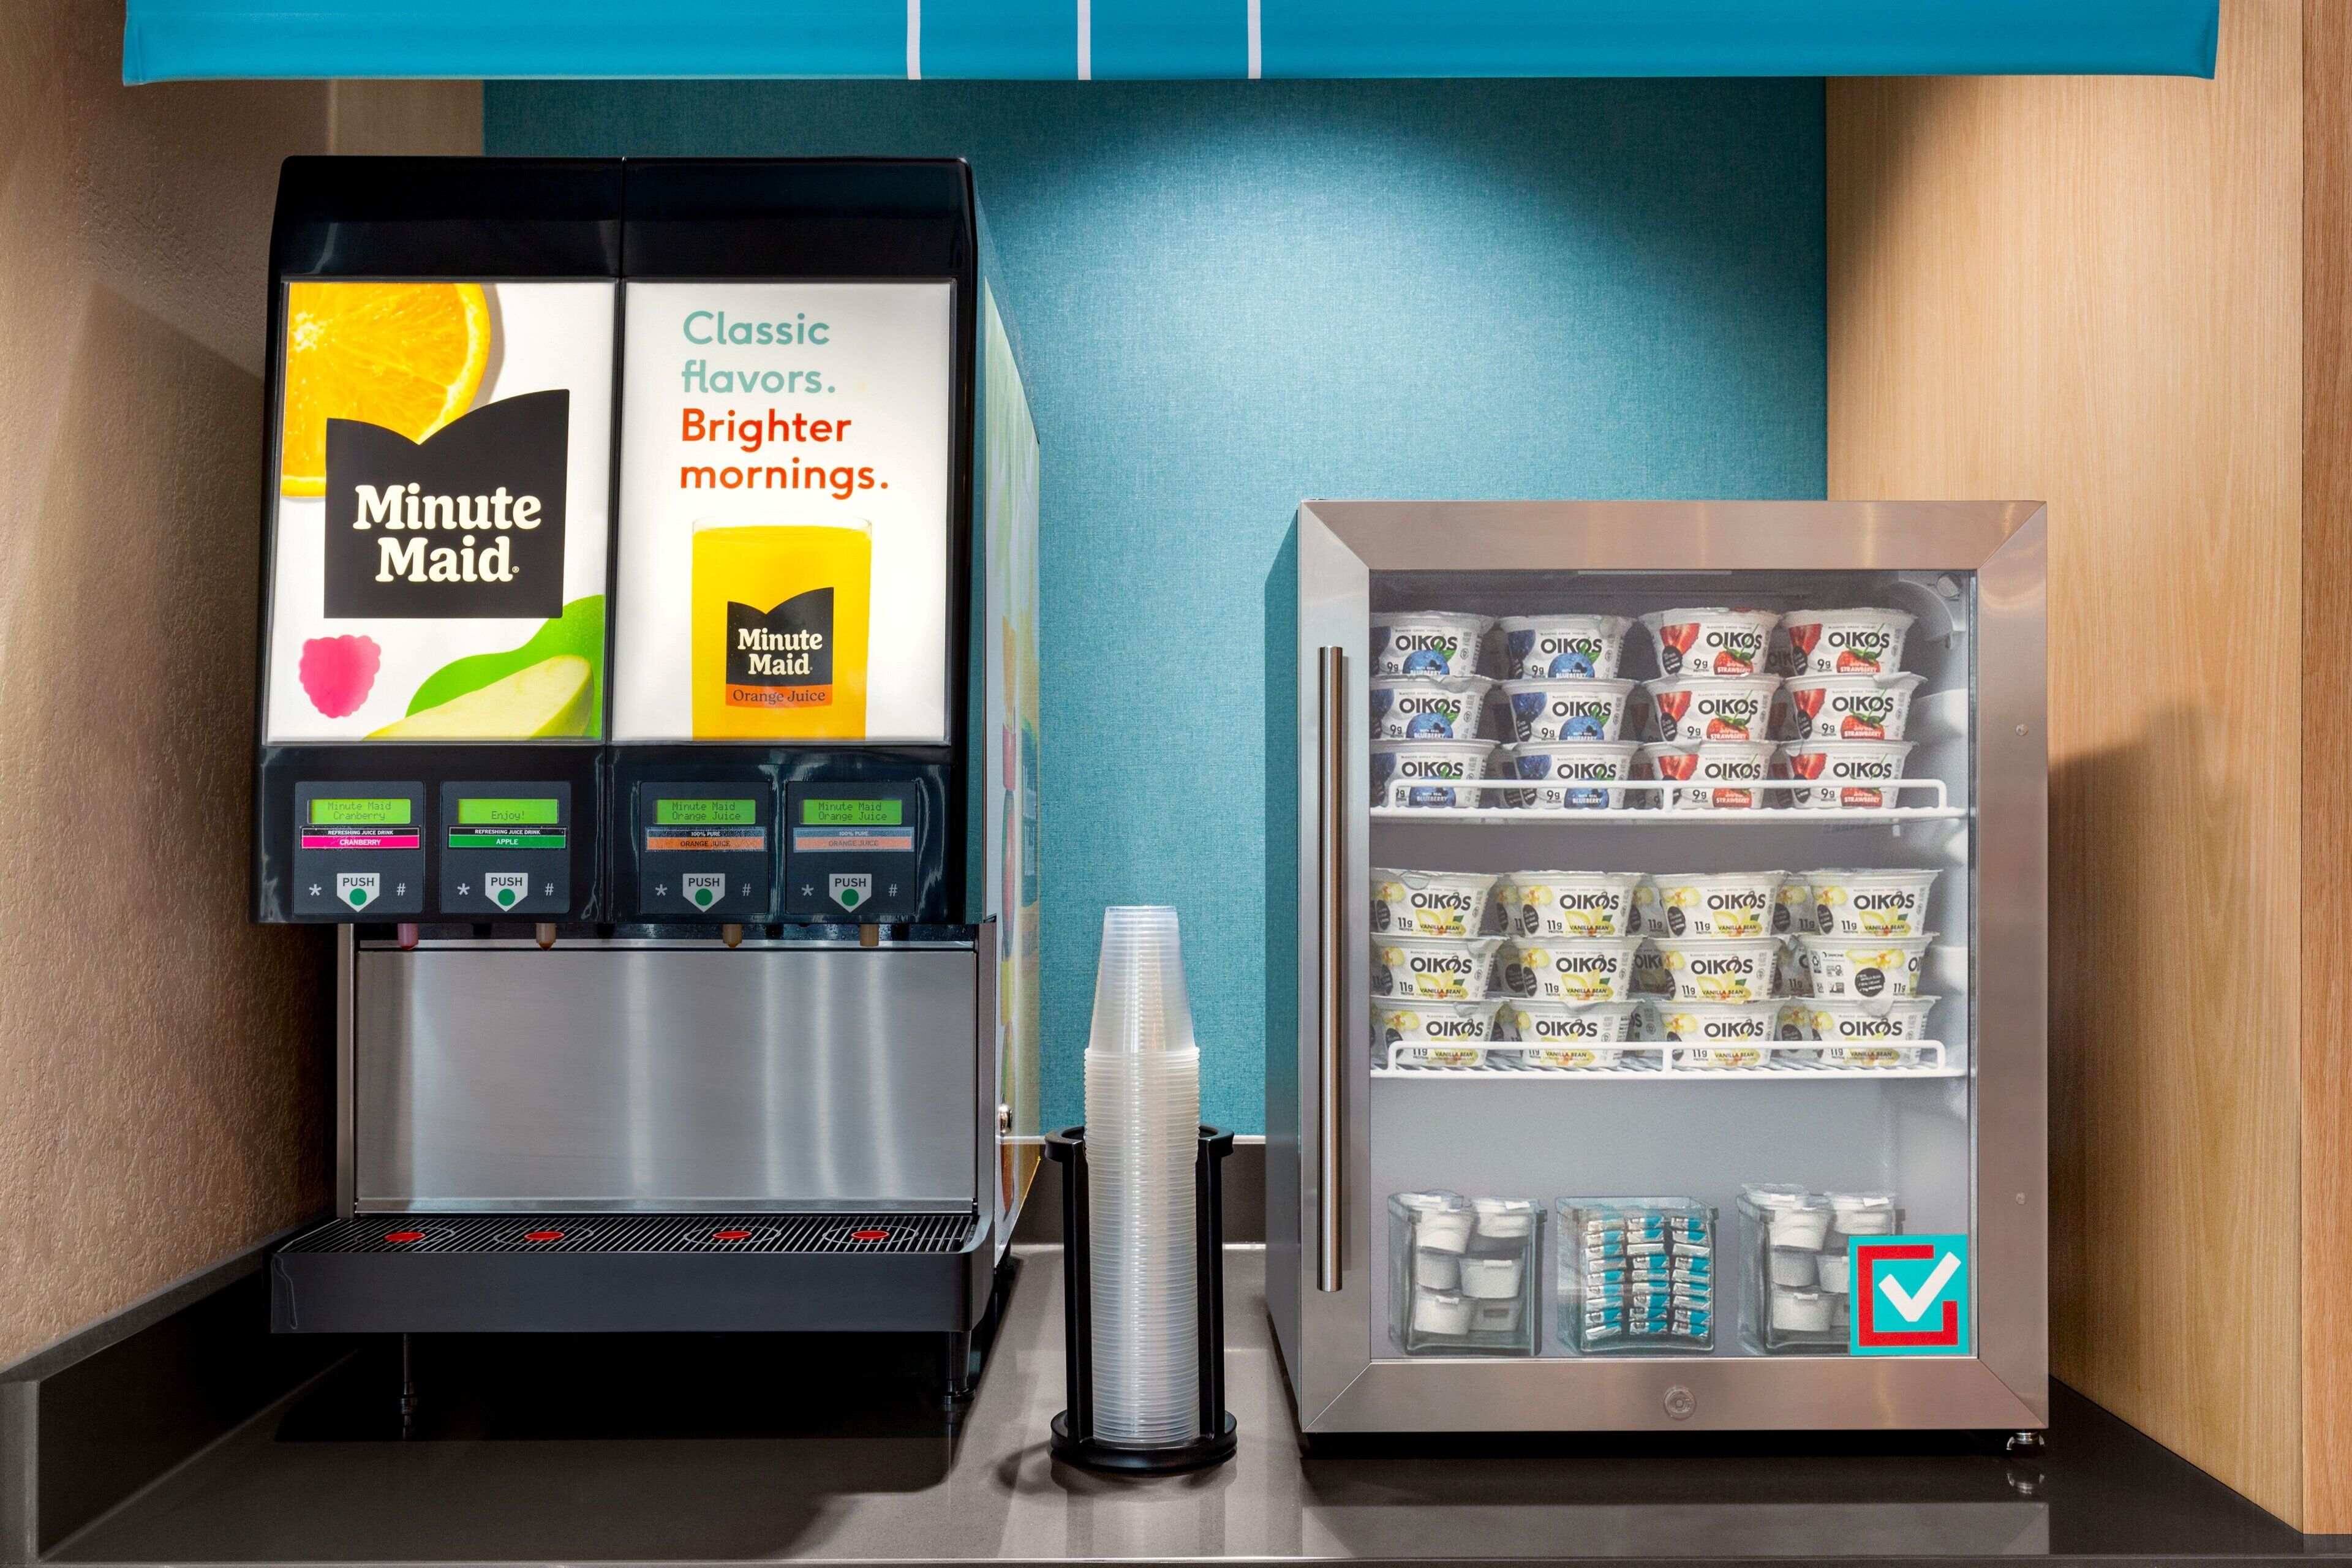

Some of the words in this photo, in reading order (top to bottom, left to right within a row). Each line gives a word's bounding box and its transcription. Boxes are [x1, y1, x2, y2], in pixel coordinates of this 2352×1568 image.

[683, 311, 830, 345] Classic
[682, 359, 835, 393] flavors.
[682, 408, 851, 453] Brighter
[680, 457, 888, 500] mornings.
[353, 483, 541, 530] Minute
[737, 627, 823, 650] Minute
[1396, 635, 1458, 650] OIKOS
[1541, 638, 1602, 654] OIKOS
[1706, 632, 1762, 649] OIKOS
[1828, 632, 1890, 648] OIKOS
[1387, 662, 1398, 672] 9g
[1532, 665, 1544, 675] 9g
[1694, 659, 1708, 668] 9g
[1817, 659, 1830, 669] 9g
[733, 690, 784, 704] Orange
[787, 690, 825, 702] Juice
[1832, 696, 1893, 712] OIKOS
[1400, 698, 1461, 713] OIKOS
[1553, 702, 1611, 717] OIKOS
[1698, 699, 1758, 714] OIKOS
[1390, 725, 1402, 734] 9g
[1542, 728, 1555, 737] 9g
[1687, 726, 1700, 736] 9g
[1822, 723, 1834, 733] 9g
[1402, 762, 1463, 777] OIKOS
[1557, 764, 1616, 778] OIKOS
[1705, 763, 1761, 778] OIKOS
[1833, 763, 1892, 778] OIKOS
[1547, 790, 1559, 800] 9g
[1693, 790, 1706, 799] 9g
[1822, 788, 1834, 798] 9g
[491, 811, 524, 820] Enjoy!
[343, 878, 374, 886] PUSH
[688, 878, 720, 886] PUSH
[835, 878, 866, 887] PUSH
[1411, 893, 1471, 911] OIKOS
[1559, 895, 1619, 910] OIKOS
[1708, 894, 1766, 910] OIKOS
[1854, 894, 1914, 910] OIKOS
[1398, 918, 1412, 927] 11g
[1547, 920, 1562, 930] 11g
[1648, 919, 1662, 929] 11g
[1694, 921, 1710, 930] 11g
[1841, 921, 1856, 930] 11g
[1411, 957, 1472, 974] OIKOS
[1556, 957, 1617, 973] OIKOS
[1691, 959, 1753, 974] OIKOS
[1400, 982, 1412, 992] 11g
[1545, 983, 1559, 993] 11g
[1682, 986, 1695, 995] 11g
[1894, 983, 1905, 992] 11g
[1427, 1021, 1483, 1036] OIKOS
[1536, 1021, 1597, 1037] OIKOS
[1705, 1022, 1763, 1037] OIKOS
[1840, 1021, 1902, 1036] OIKOS
